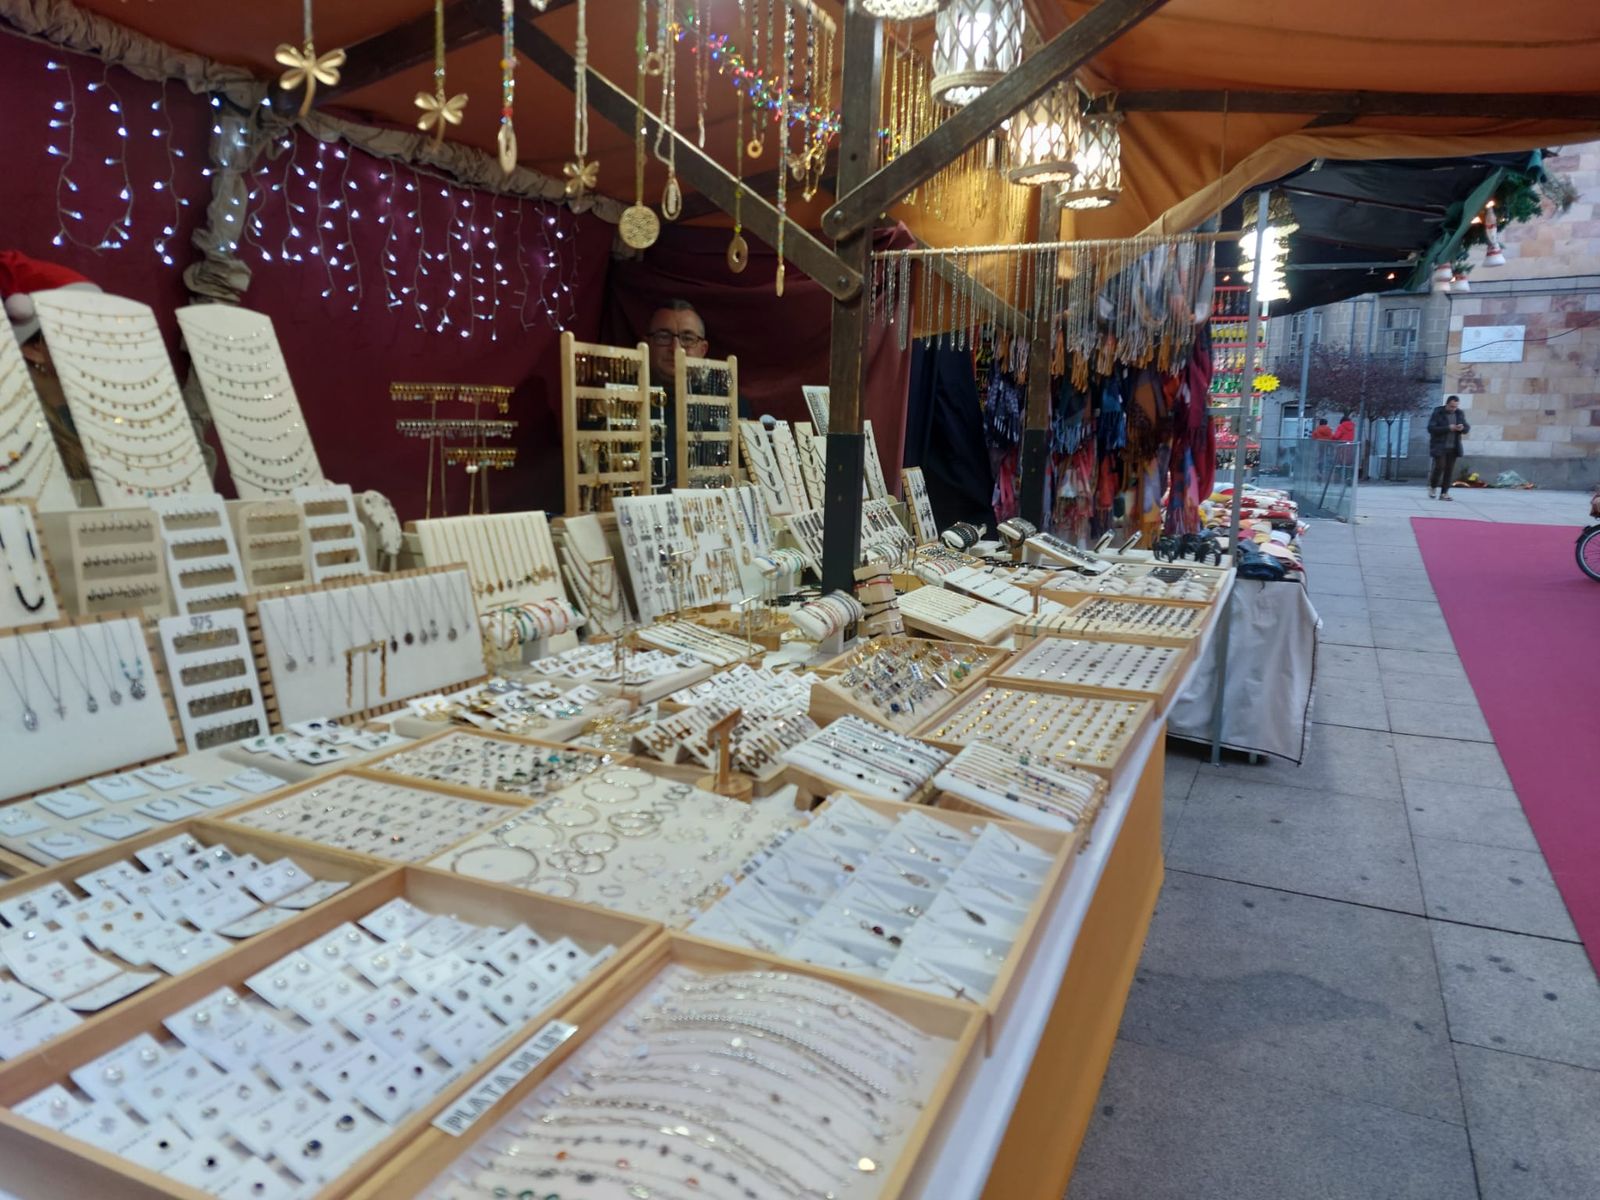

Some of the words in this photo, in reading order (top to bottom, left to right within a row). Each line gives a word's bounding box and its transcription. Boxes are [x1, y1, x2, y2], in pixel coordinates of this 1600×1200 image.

[443, 1074, 517, 1129] PLATA
[510, 1052, 541, 1072] DE
[534, 1024, 561, 1050] LEY
